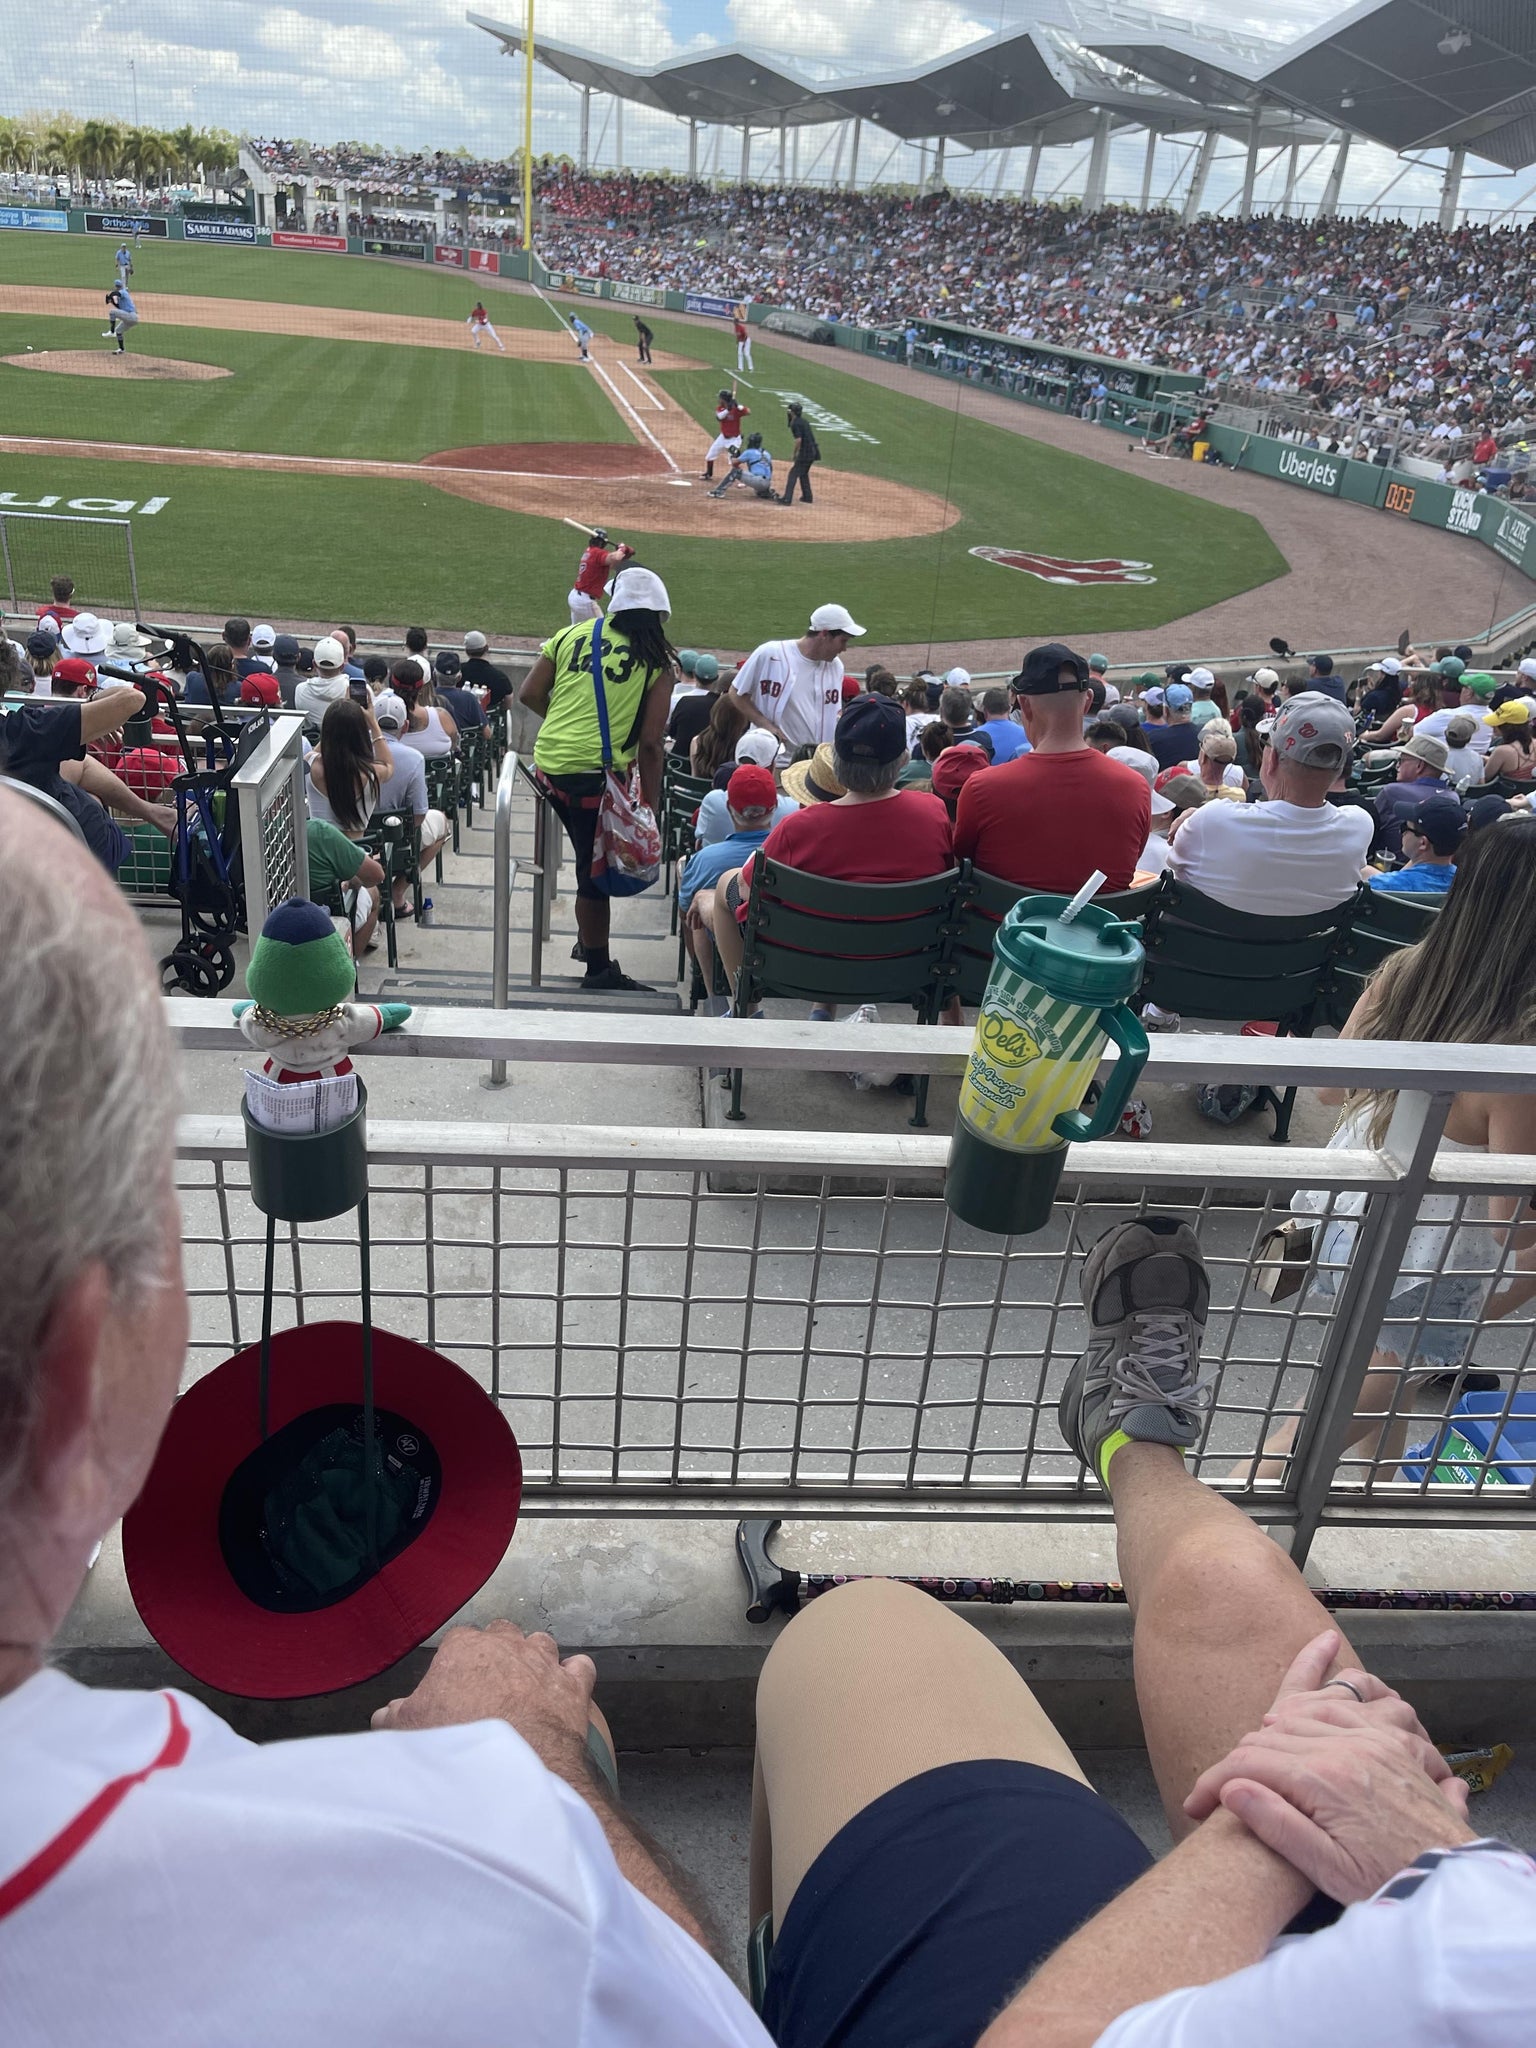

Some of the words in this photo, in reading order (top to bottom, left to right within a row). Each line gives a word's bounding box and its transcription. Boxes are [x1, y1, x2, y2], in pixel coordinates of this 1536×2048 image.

[187, 223, 221, 235] SAMUEL
[223, 226, 253, 239] ADAMS
[256, 226, 272, 236] 380
[1452, 489, 1477, 511] KICK
[1447, 507, 1482, 531] STAND
[568, 635, 636, 684] 123
[1000, 988, 1016, 1005] SIGN
[1016, 1002, 1029, 1013] OF
[1027, 1009, 1046, 1027] THE
[1041, 1024, 1063, 1053] LEMON
[969, 1070, 1016, 1109] Lemonade
[984, 1068, 1026, 1097] Frozen
